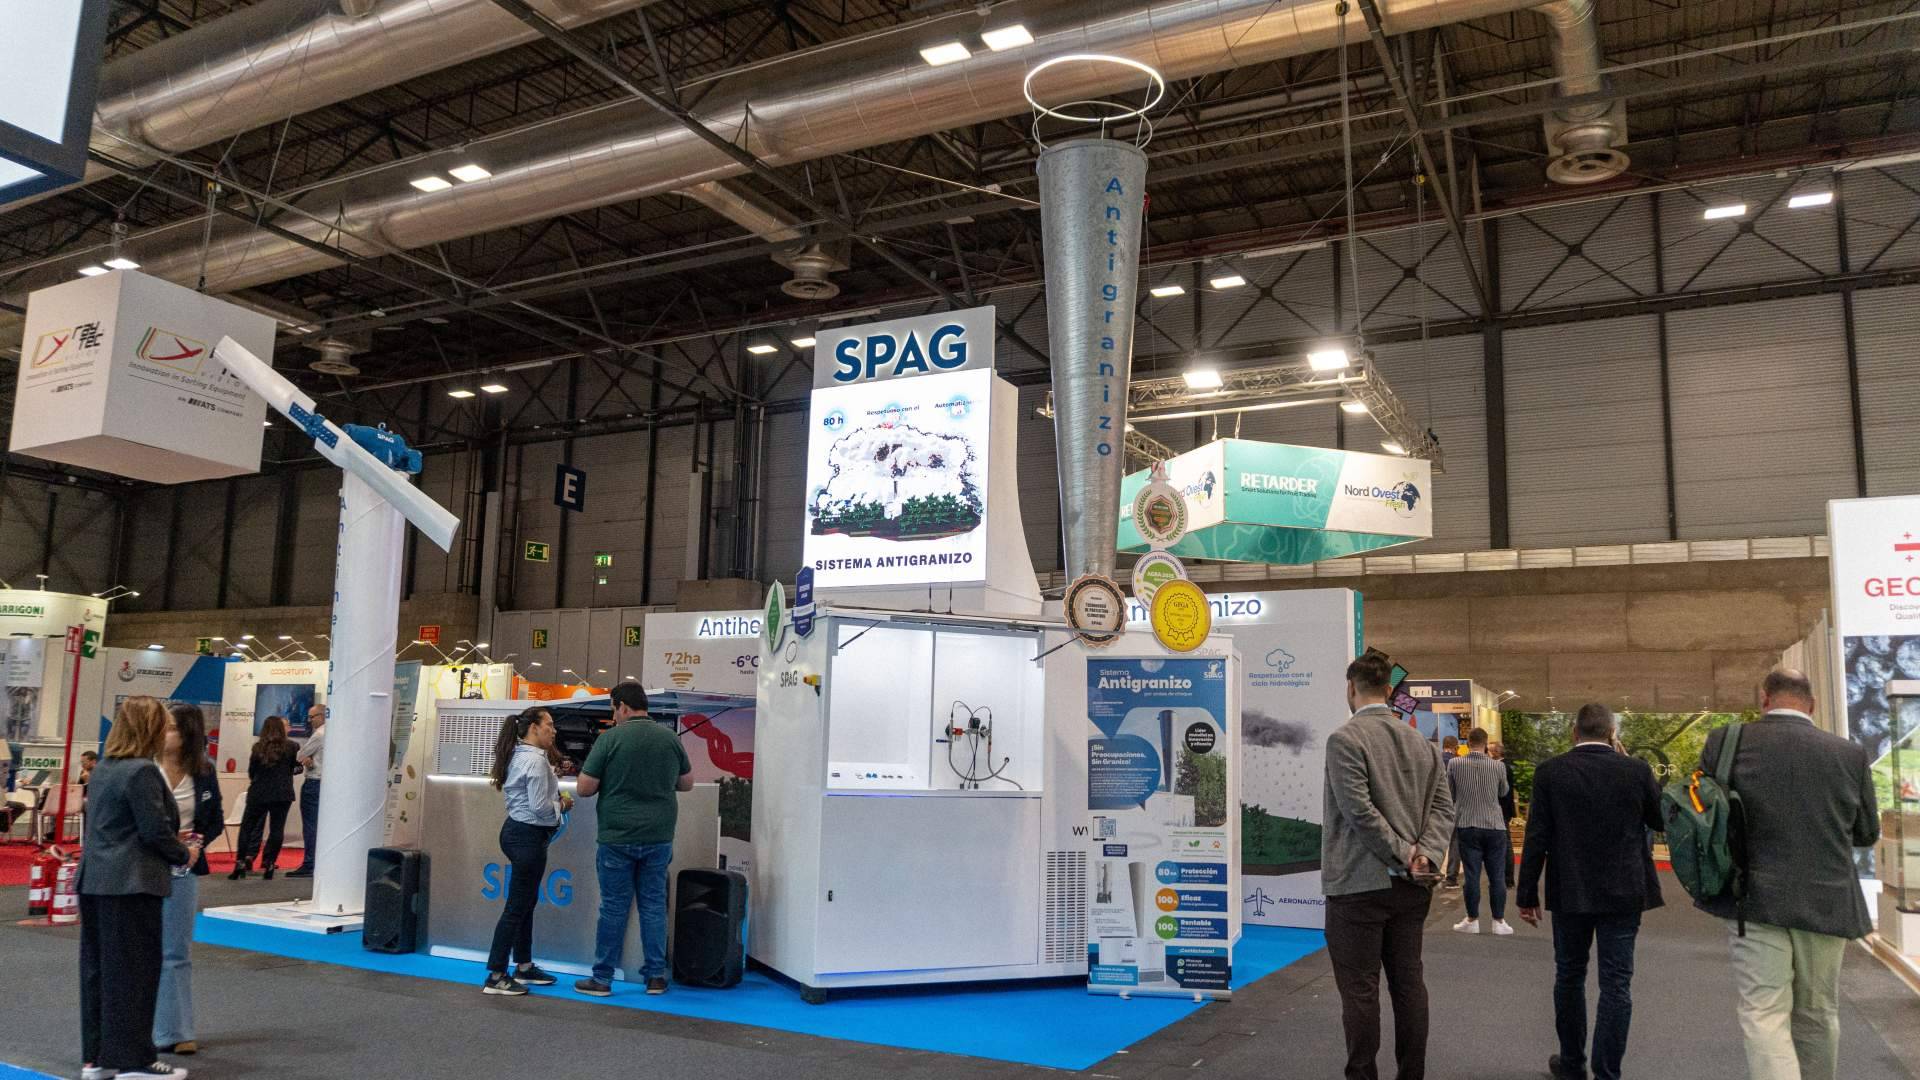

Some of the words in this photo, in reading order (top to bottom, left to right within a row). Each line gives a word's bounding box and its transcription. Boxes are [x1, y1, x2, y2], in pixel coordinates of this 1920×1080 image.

[1096, 176, 1124, 457] Antigranizo
[832, 324, 967, 382] SPAG
[181, 375, 207, 390] Sorting
[208, 384, 246, 400] Equipment
[823, 416, 836, 426] 80
[836, 415, 844, 425] h
[562, 471, 577, 505] E
[1240, 472, 1319, 493] RETARDER
[1344, 484, 1370, 497] Nord
[1371, 486, 1400, 500] Ovest
[815, 558, 872, 571] SISTEMA
[876, 552, 973, 569] ANTIGRANIZO
[664, 652, 701, 668] 7,2ha
[780, 671, 798, 688] SPAG
[1097, 675, 1193, 693] Antigranizo
[480, 862, 574, 908] SG
